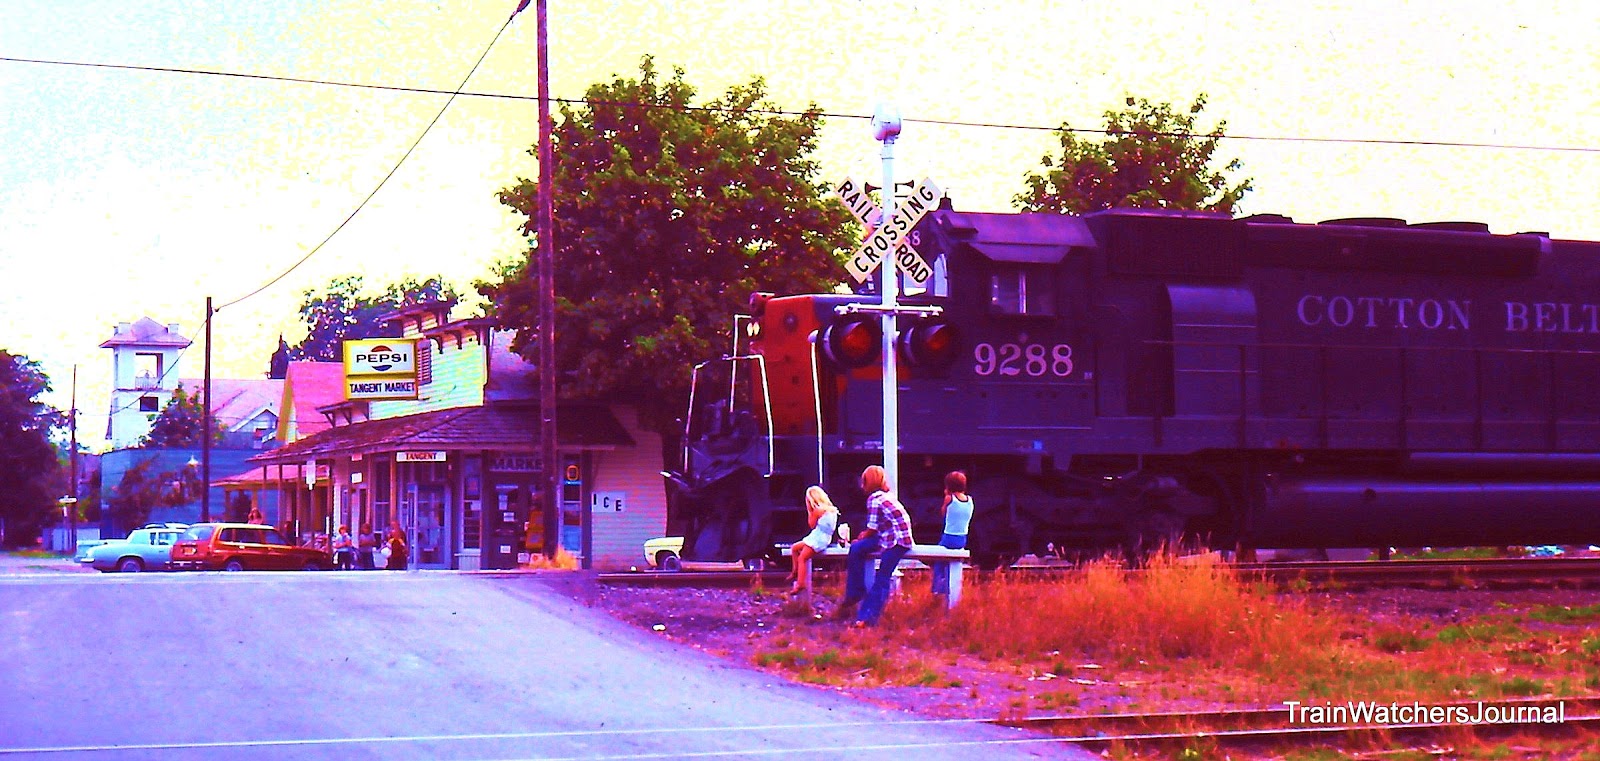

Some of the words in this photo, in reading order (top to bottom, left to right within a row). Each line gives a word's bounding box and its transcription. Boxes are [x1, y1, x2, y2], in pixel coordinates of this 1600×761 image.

[837, 180, 873, 223] RAIL
[895, 243, 929, 283] ROAD
[853, 186, 934, 273] CROSSING
[1296, 294, 1473, 330] COTTON
[1503, 301, 1600, 334] BELT
[356, 353, 407, 363] PEPSI
[974, 342, 1073, 377] 9288
[349, 383, 382, 393] TANGENT
[384, 382, 415, 392] MARKET
[405, 452, 437, 460] TANGENT
[491, 457, 543, 470] MARKE
[593, 493, 622, 511] ICE
